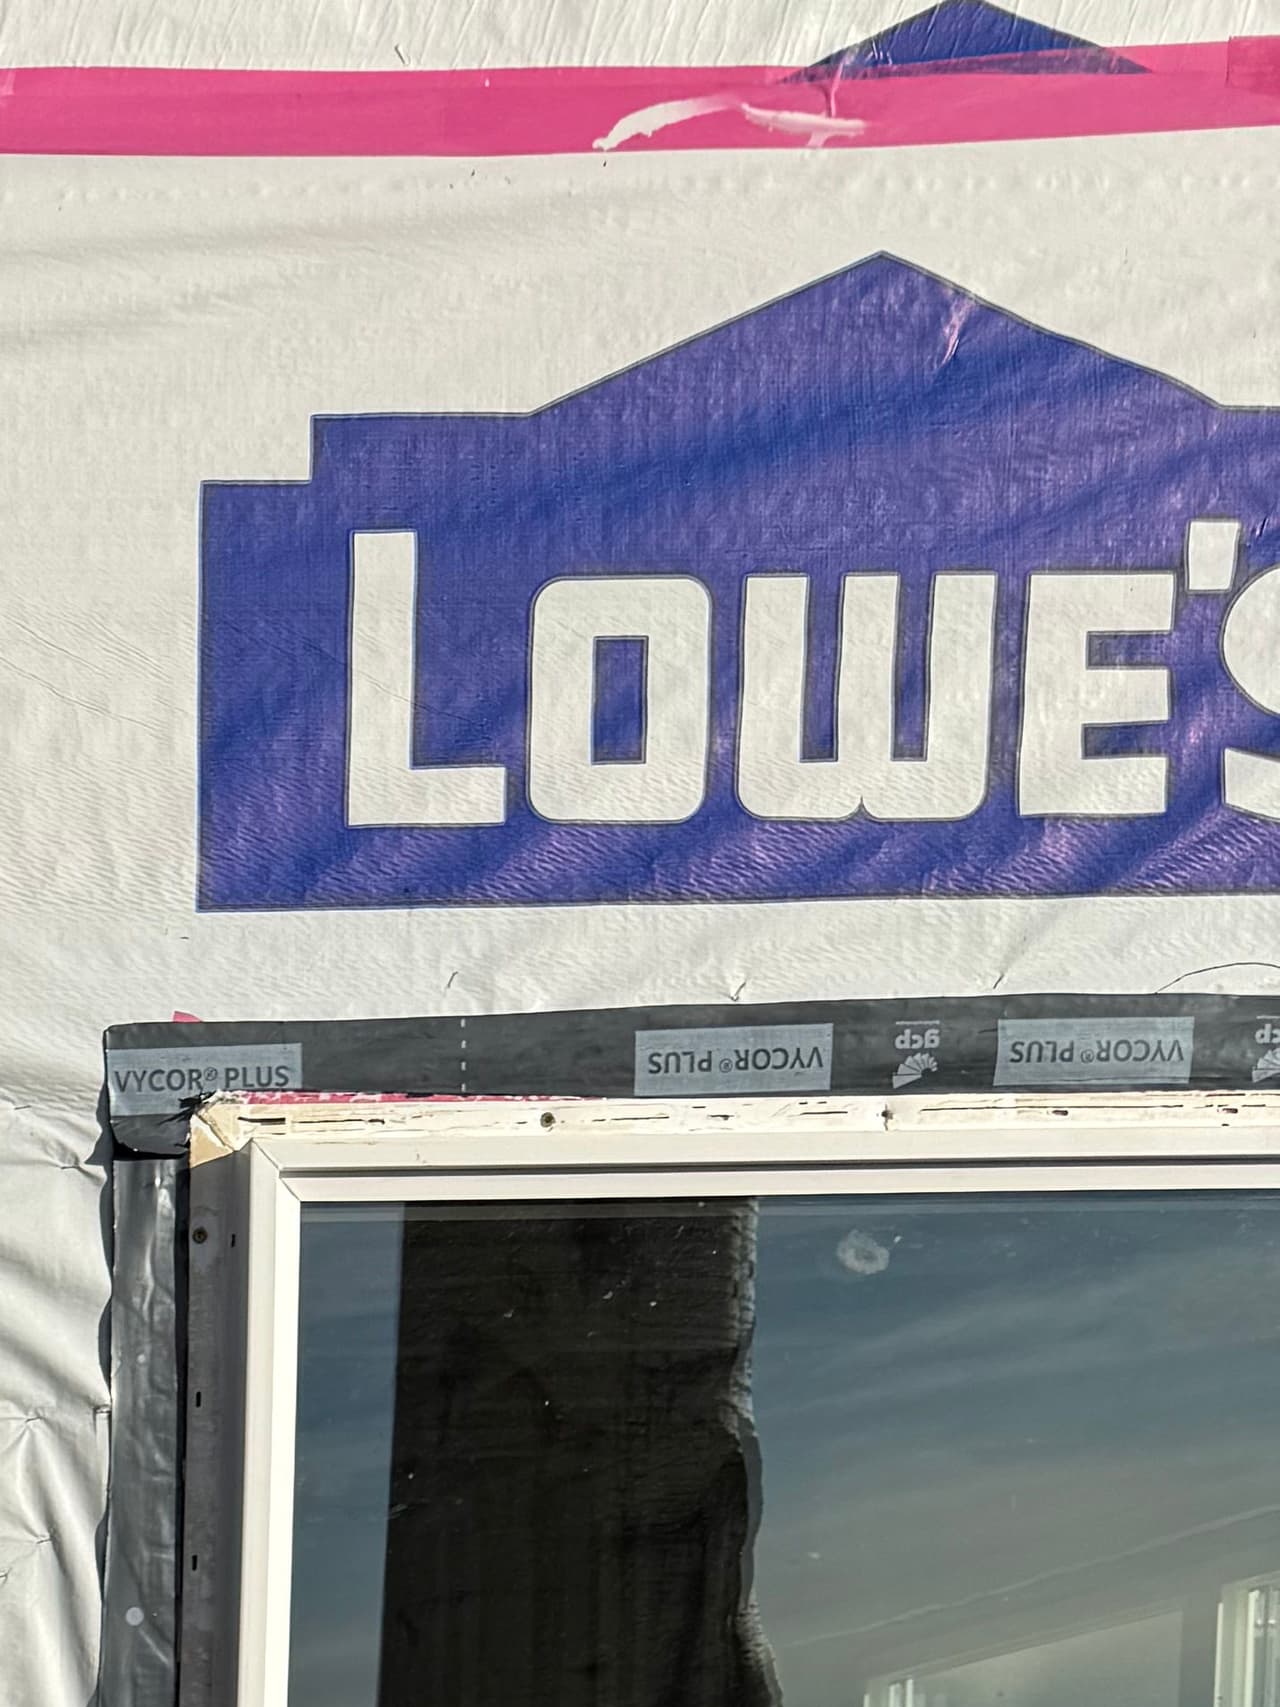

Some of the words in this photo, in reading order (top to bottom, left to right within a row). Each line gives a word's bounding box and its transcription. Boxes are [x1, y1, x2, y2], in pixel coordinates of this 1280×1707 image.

[648, 1050, 713, 1075] PLUS
[1009, 1040, 1075, 1063] PLUS
[225, 1065, 290, 1089] PLUS
